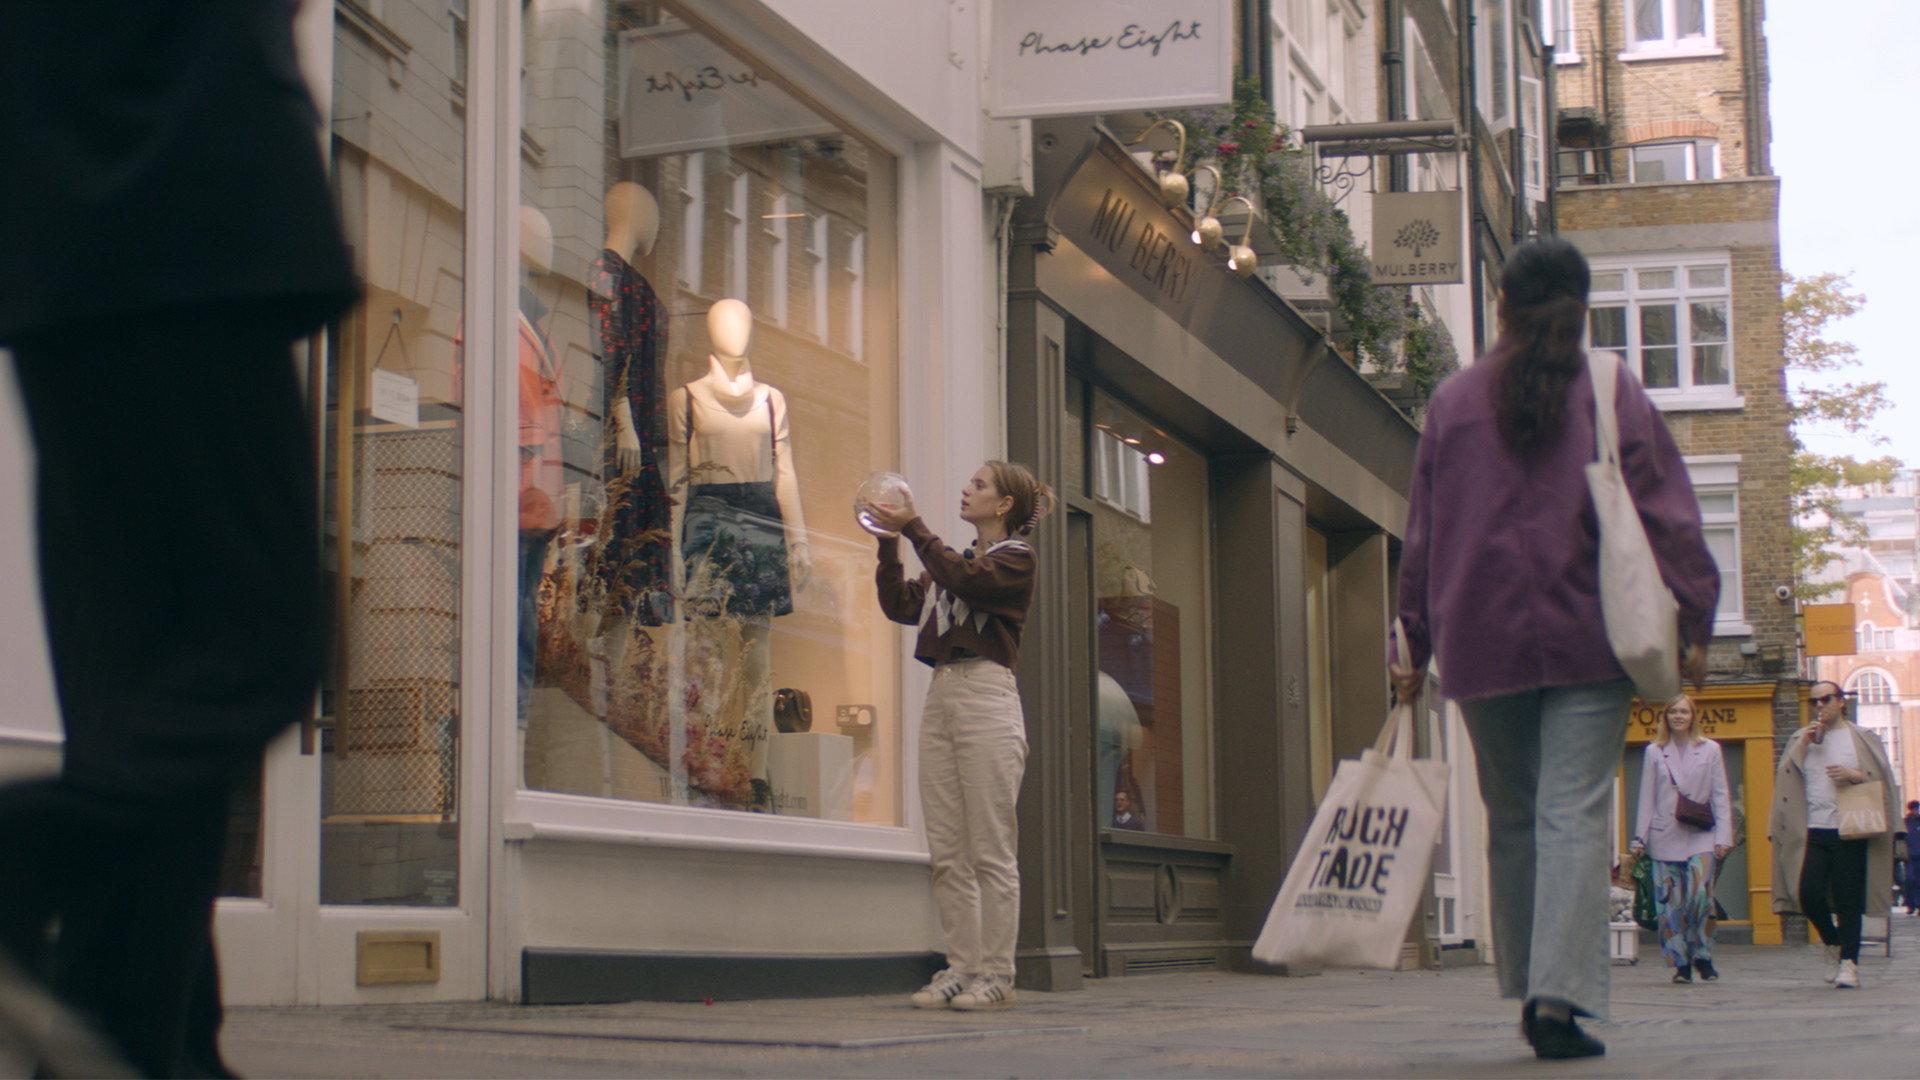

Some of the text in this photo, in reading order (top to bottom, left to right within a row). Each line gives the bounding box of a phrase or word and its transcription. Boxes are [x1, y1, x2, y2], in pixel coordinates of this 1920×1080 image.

[1018, 20, 1201, 57] Phase Eight
[1375, 262, 1458, 277] MULBERRY
[1308, 846, 1396, 895] TADE
